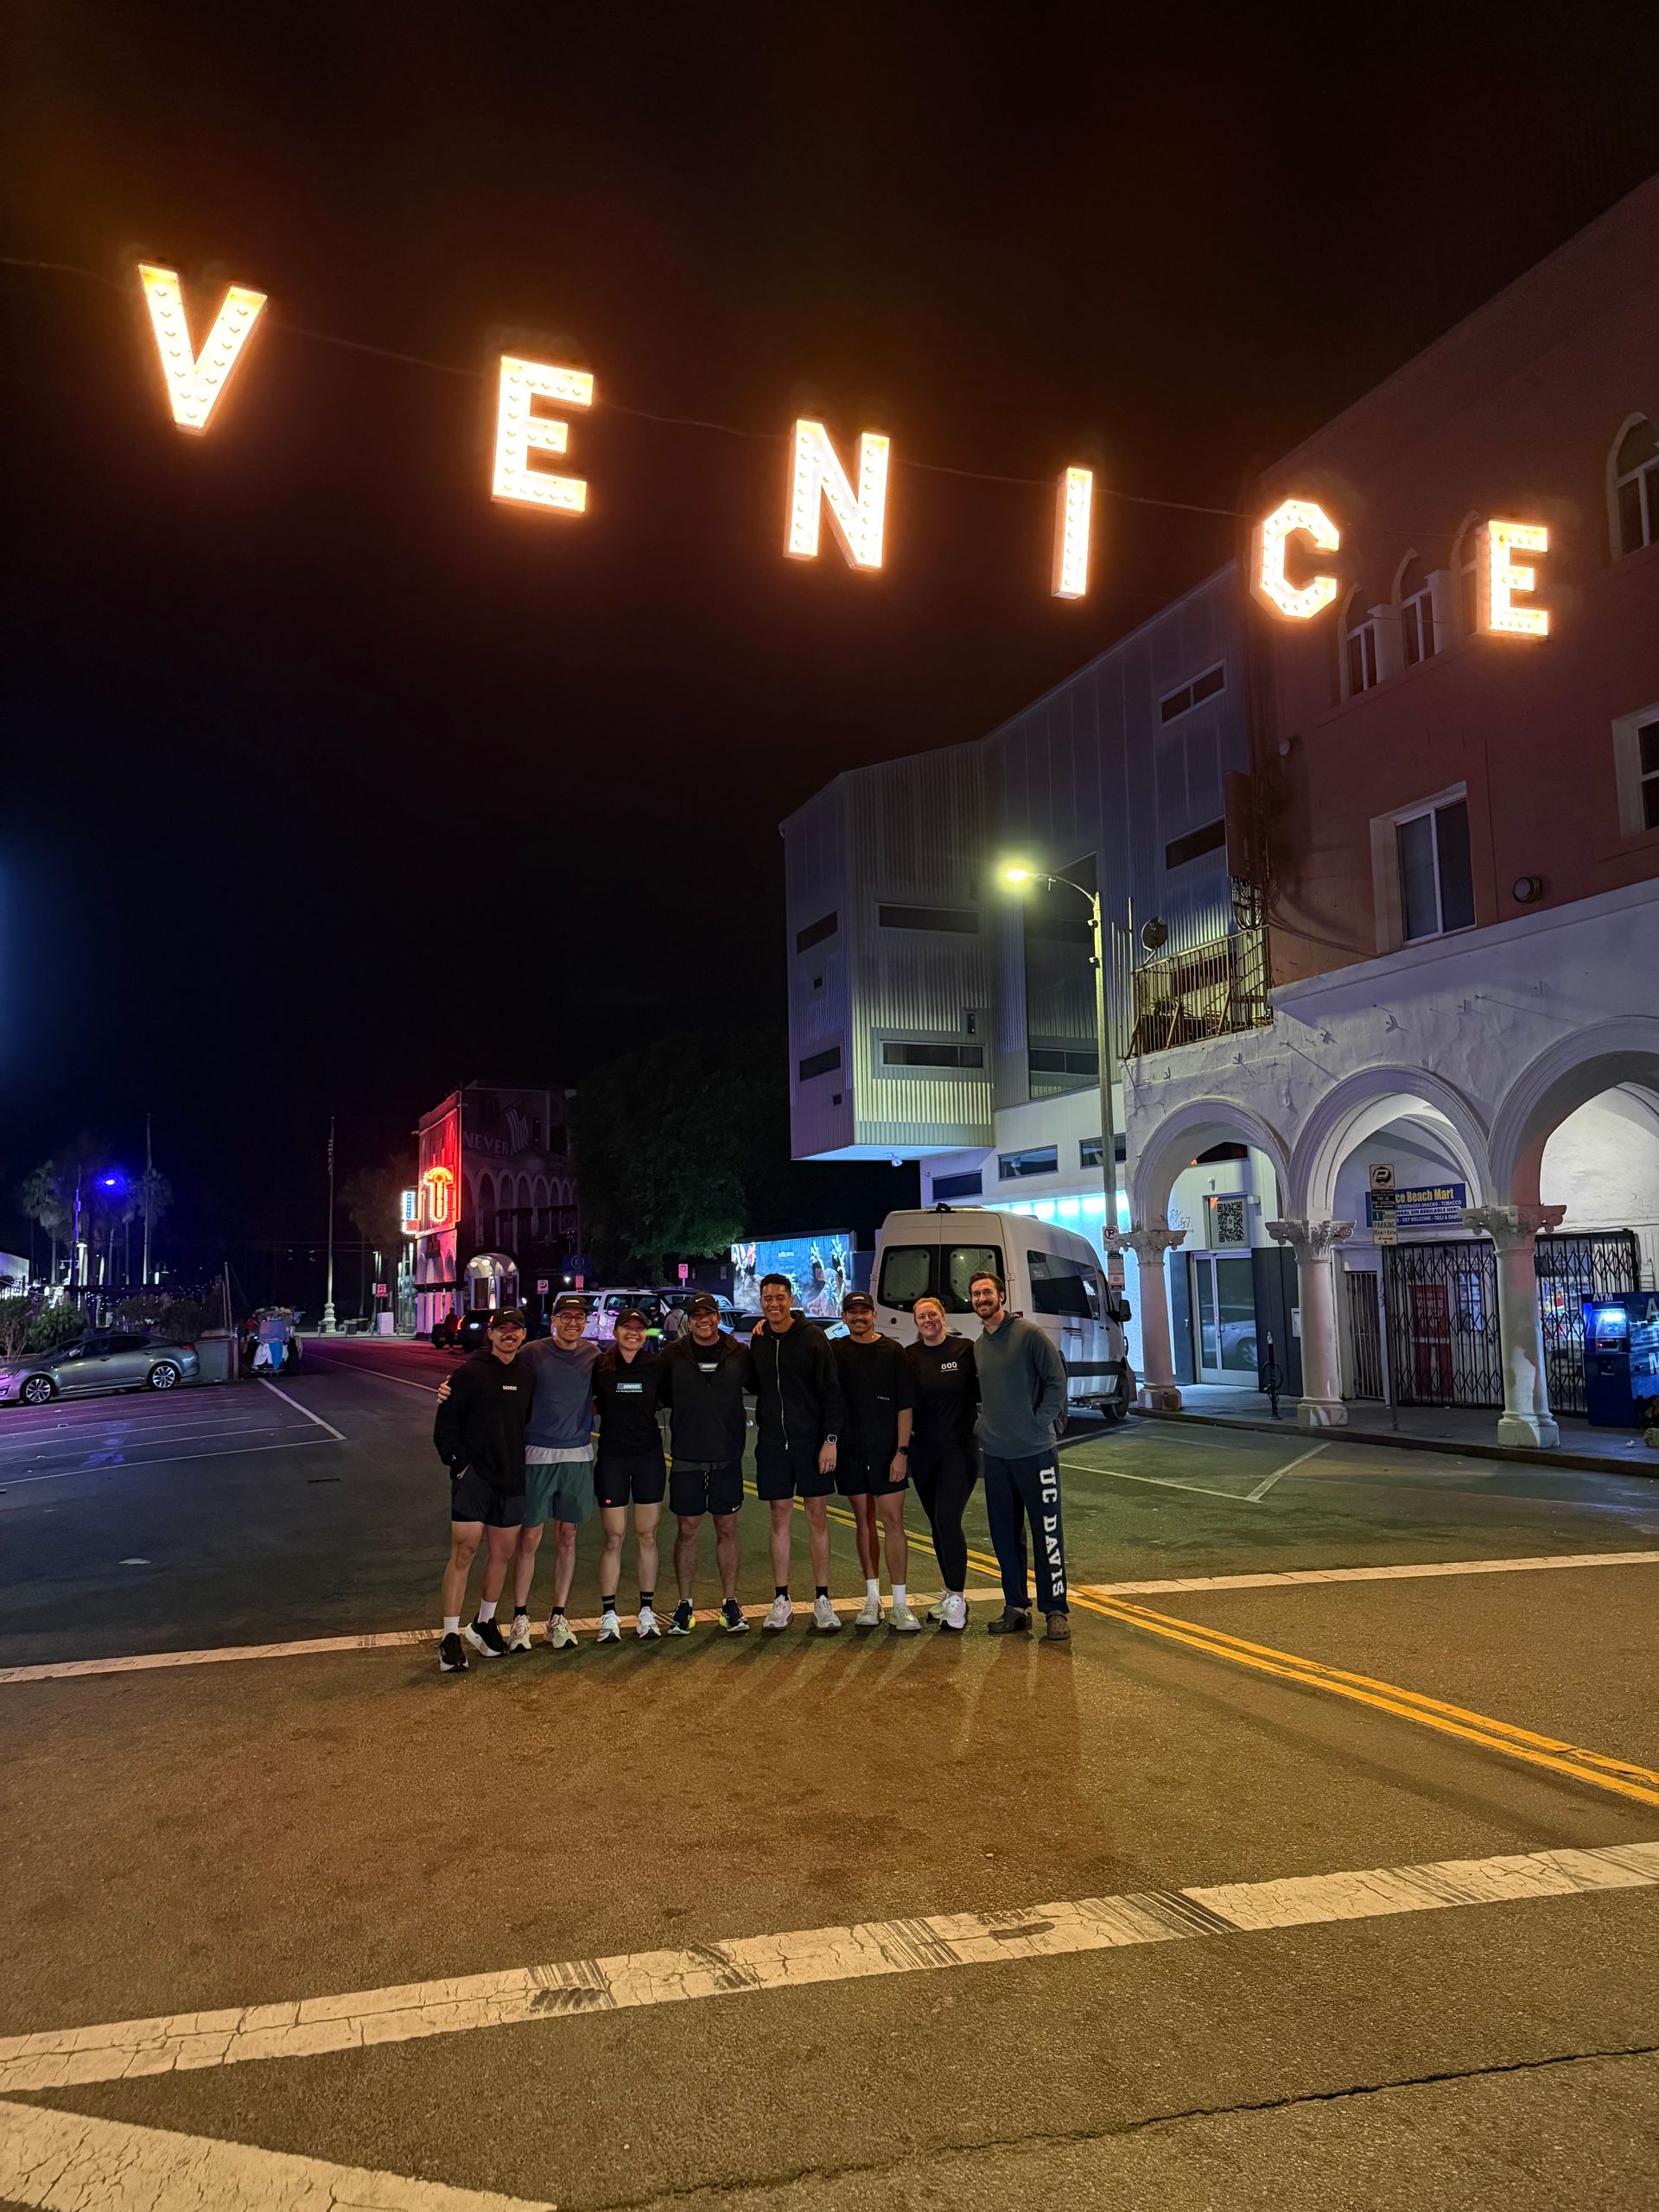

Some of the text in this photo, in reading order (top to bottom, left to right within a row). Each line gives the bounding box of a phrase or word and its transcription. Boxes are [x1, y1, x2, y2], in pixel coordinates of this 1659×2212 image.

[138, 263, 1550, 638] VENICE
[463, 1130, 509, 1156] NEVER
[1406, 1189, 1433, 1203] Beach
[1433, 1187, 1454, 1201] Mart
[1592, 1293, 1613, 1302] ATM
[1039, 1466, 1065, 1598] UC DAVIS
